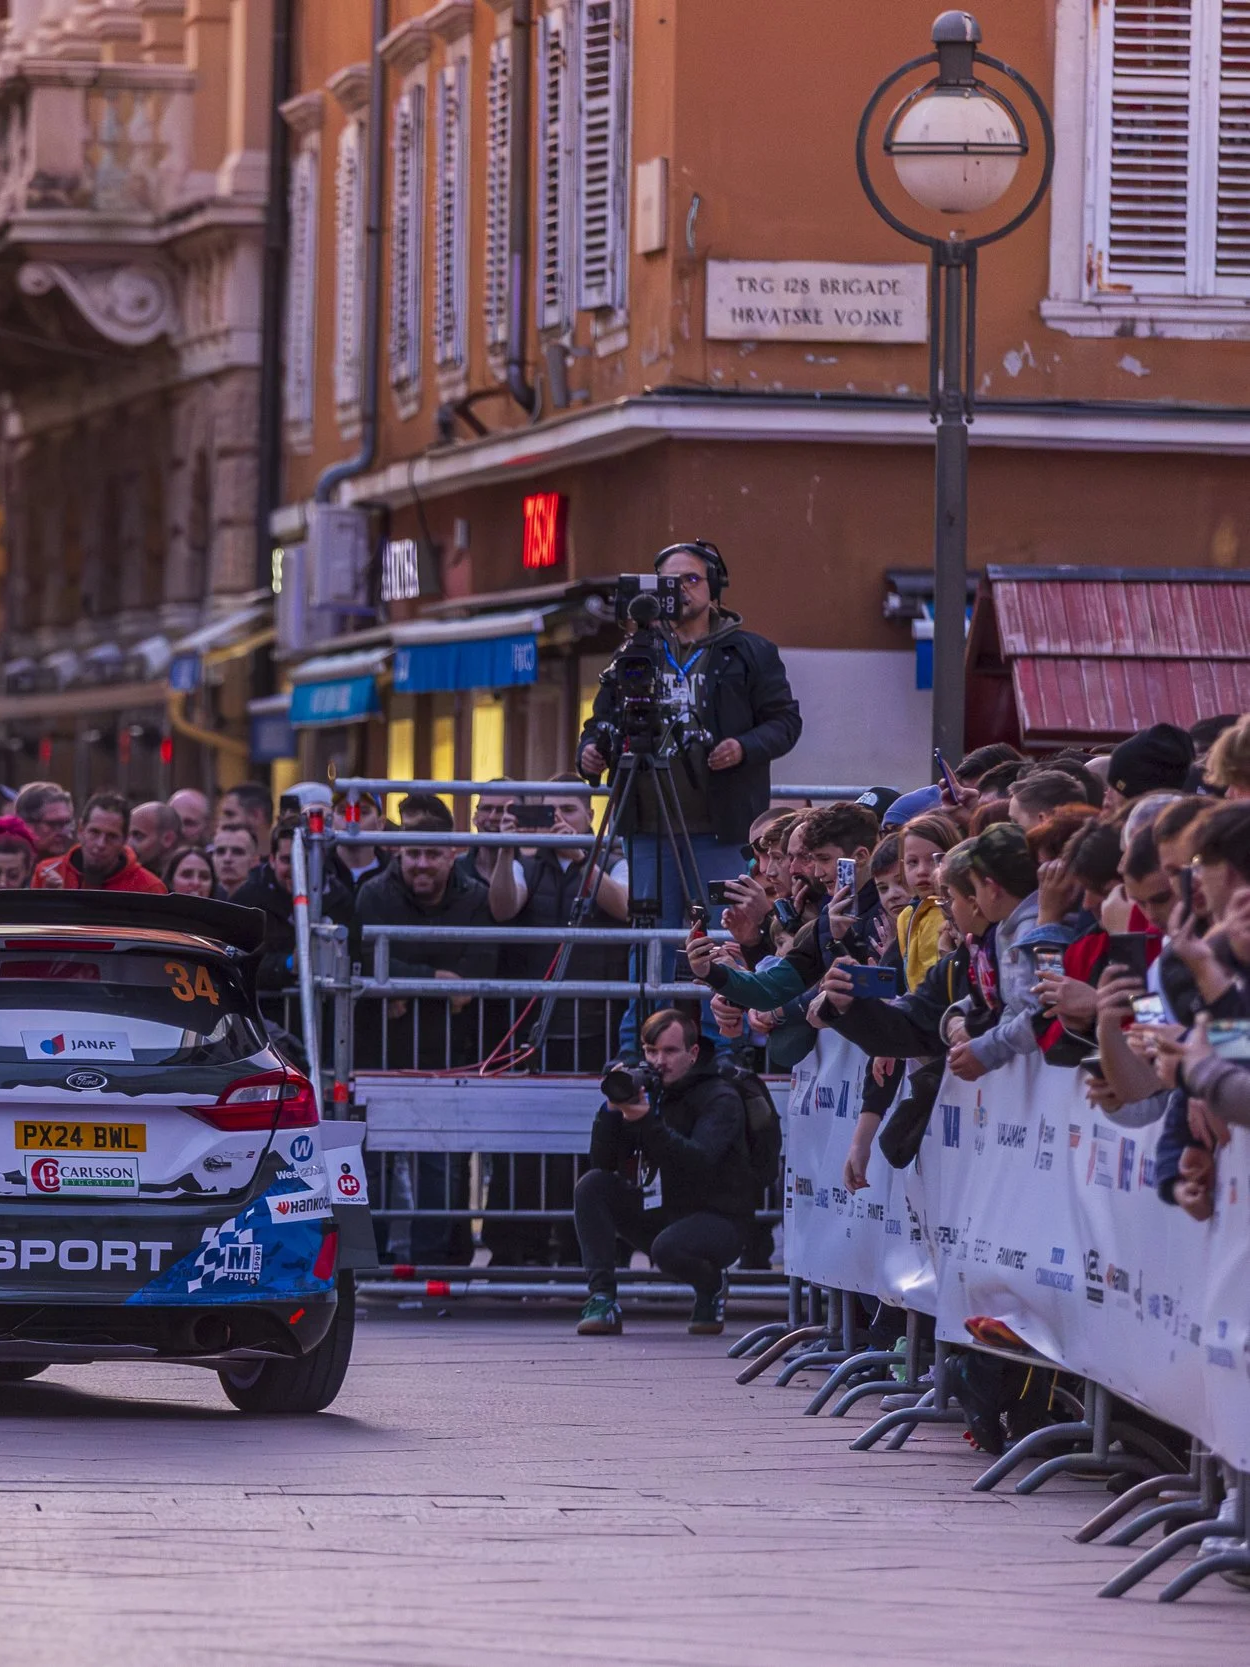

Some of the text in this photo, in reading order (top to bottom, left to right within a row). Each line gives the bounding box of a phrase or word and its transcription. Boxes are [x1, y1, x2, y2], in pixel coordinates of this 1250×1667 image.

[736, 276, 903, 296] TRG 128 BRIGADE
[731, 307, 904, 328] HRVATSKE VOJSKE
[164, 961, 220, 1006] 34
[71, 1039, 117, 1050] JANAF
[75, 1075, 99, 1086] Ford
[23, 1124, 138, 1149] PX24 BWL
[60, 1166, 133, 1179] CARLSSON
[64, 1179, 113, 1187] BYGGARE
[228, 1245, 261, 1271] M SPORT
